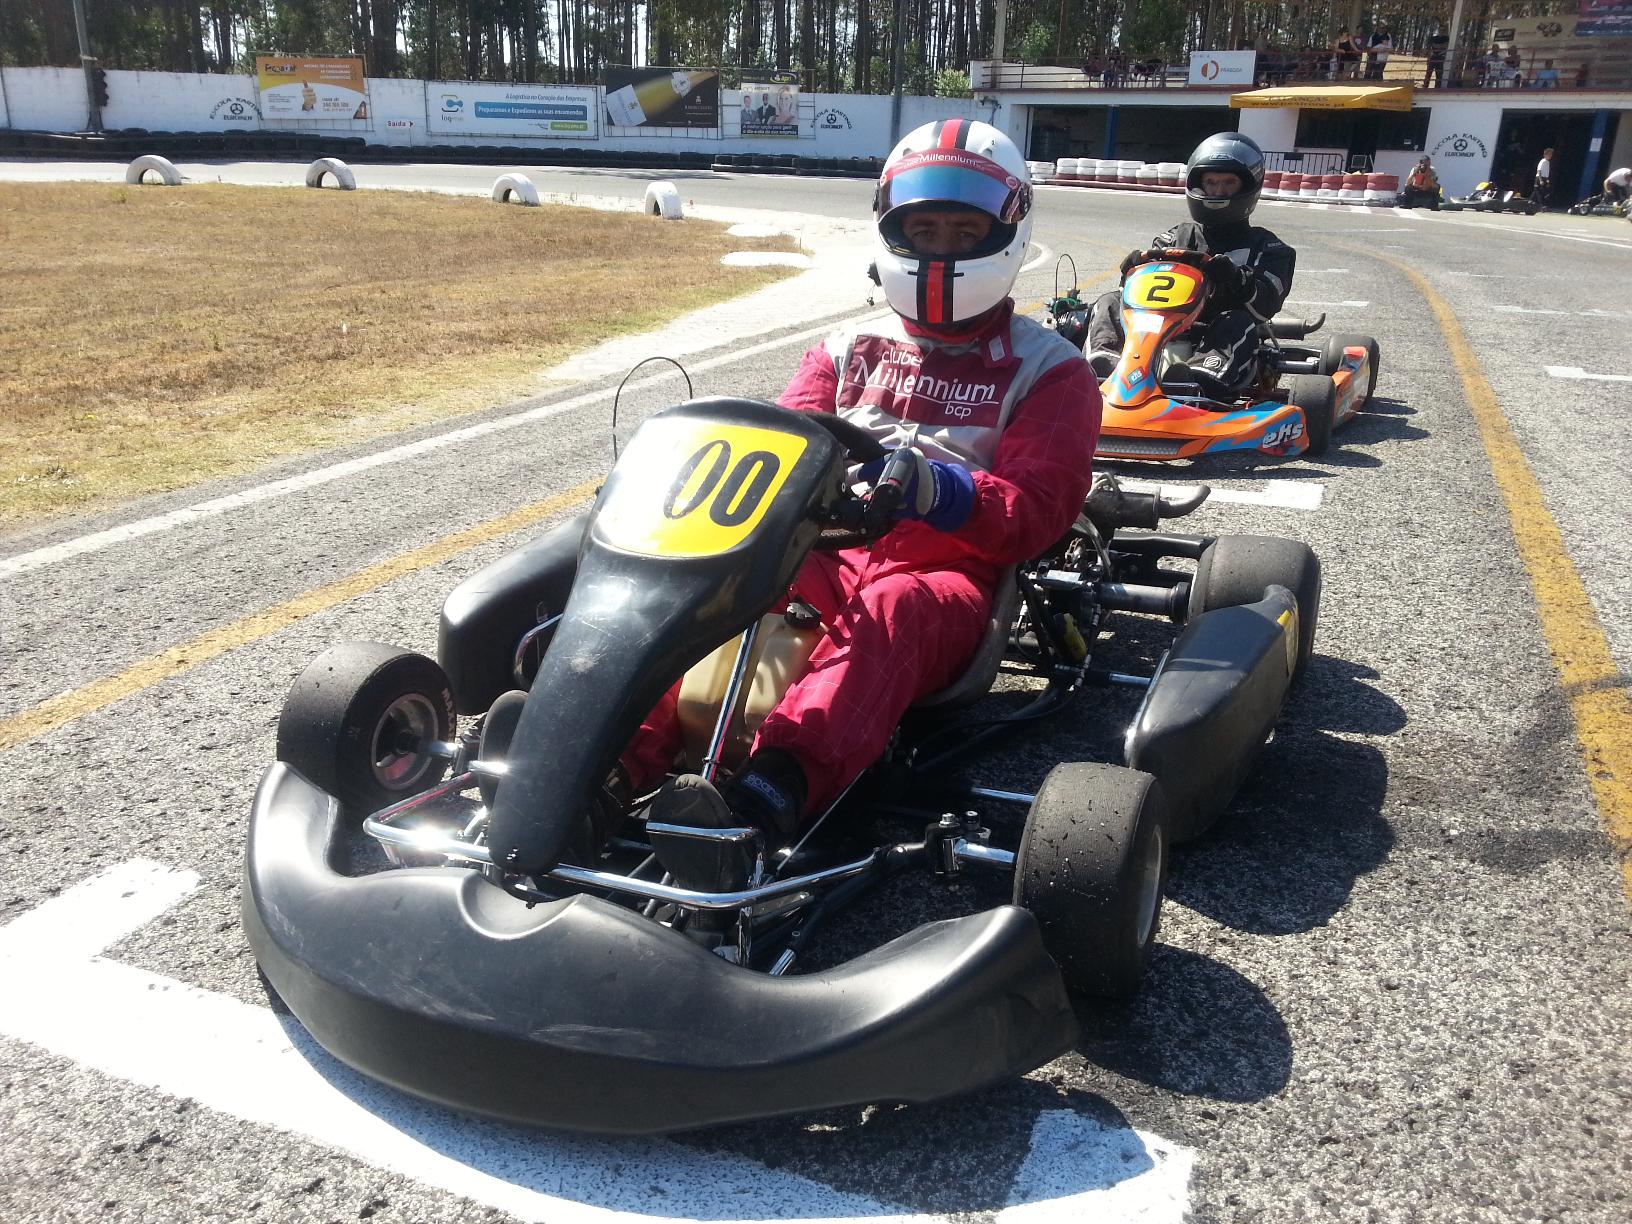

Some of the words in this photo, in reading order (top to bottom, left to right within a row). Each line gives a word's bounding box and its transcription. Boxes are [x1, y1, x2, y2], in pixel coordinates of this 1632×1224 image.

[917, 153, 976, 166] Millennium
[1146, 275, 1176, 303] 2
[881, 346, 924, 368] clube
[853, 355, 997, 402] Millennium
[944, 402, 972, 419] bcp
[663, 438, 781, 528] 00
